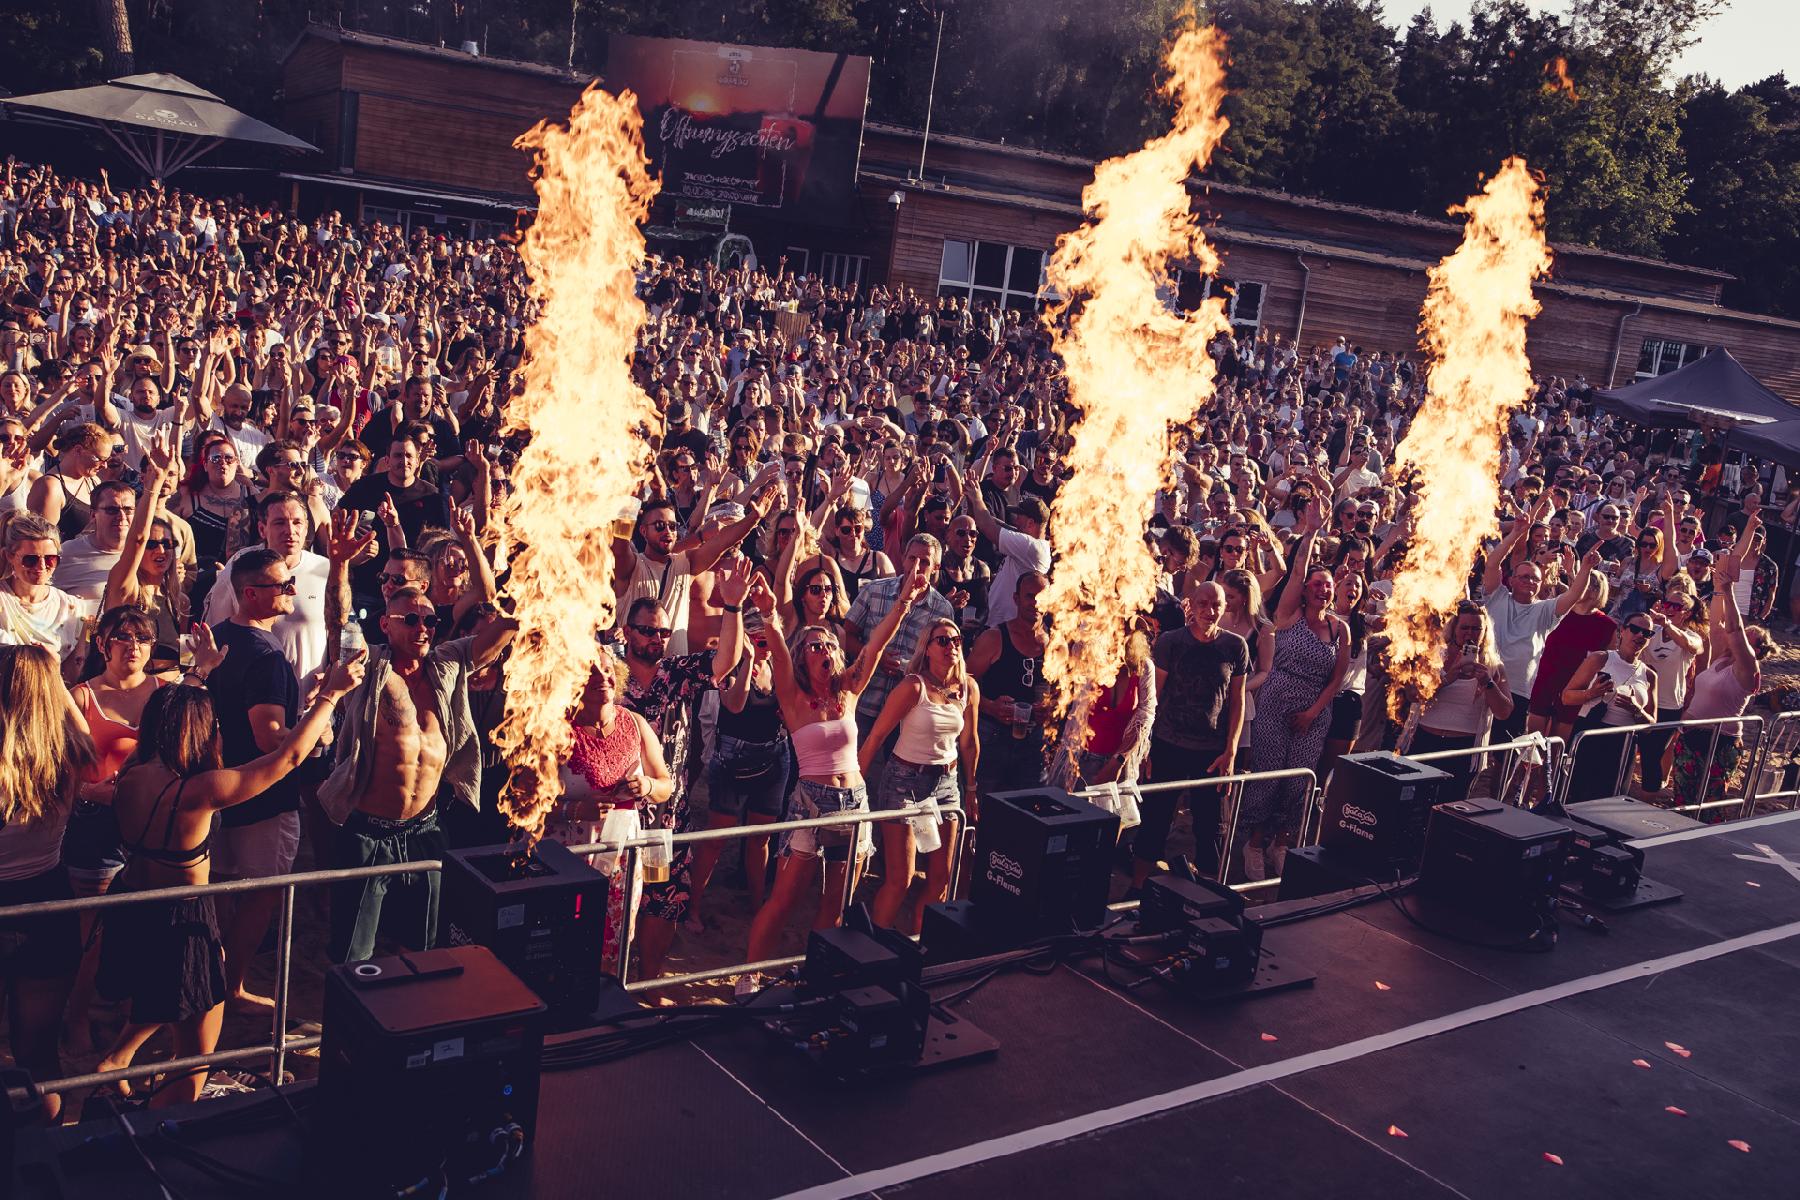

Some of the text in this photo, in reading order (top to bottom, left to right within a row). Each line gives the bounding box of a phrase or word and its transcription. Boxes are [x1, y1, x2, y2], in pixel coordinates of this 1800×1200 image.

[659, 101, 796, 160] Öffnungszeiten
[1339, 819, 1375, 841] G-Flame
[986, 870, 1021, 896] G-Flame
